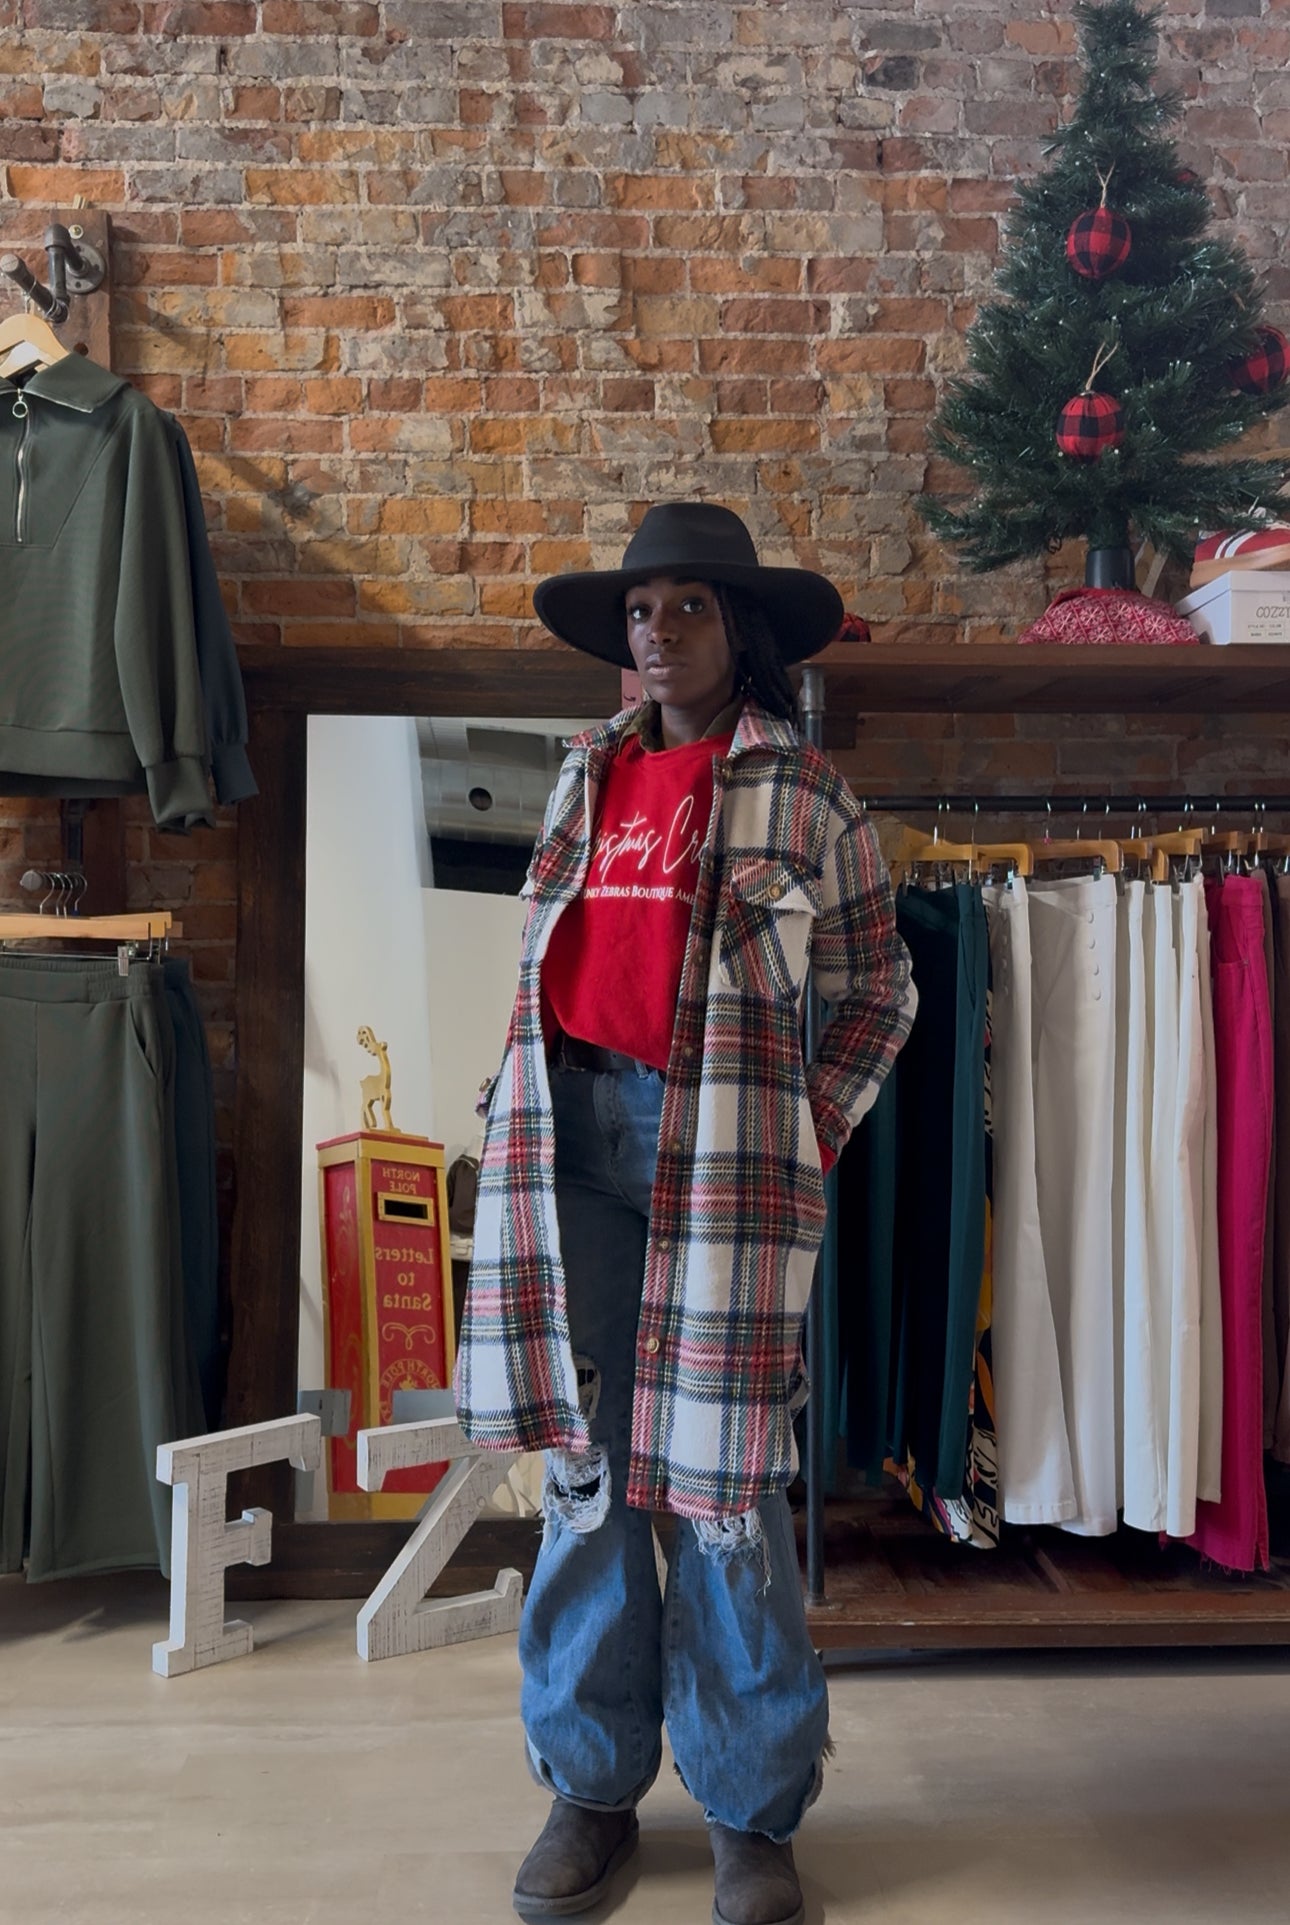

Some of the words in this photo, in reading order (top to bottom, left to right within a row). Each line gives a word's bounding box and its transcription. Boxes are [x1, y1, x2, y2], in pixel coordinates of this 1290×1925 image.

[591, 811, 662, 884] istmas
[584, 887, 601, 899] NKY
[600, 885, 630, 897] ZEBRAS
[631, 884, 674, 901] BOUTIQUE
